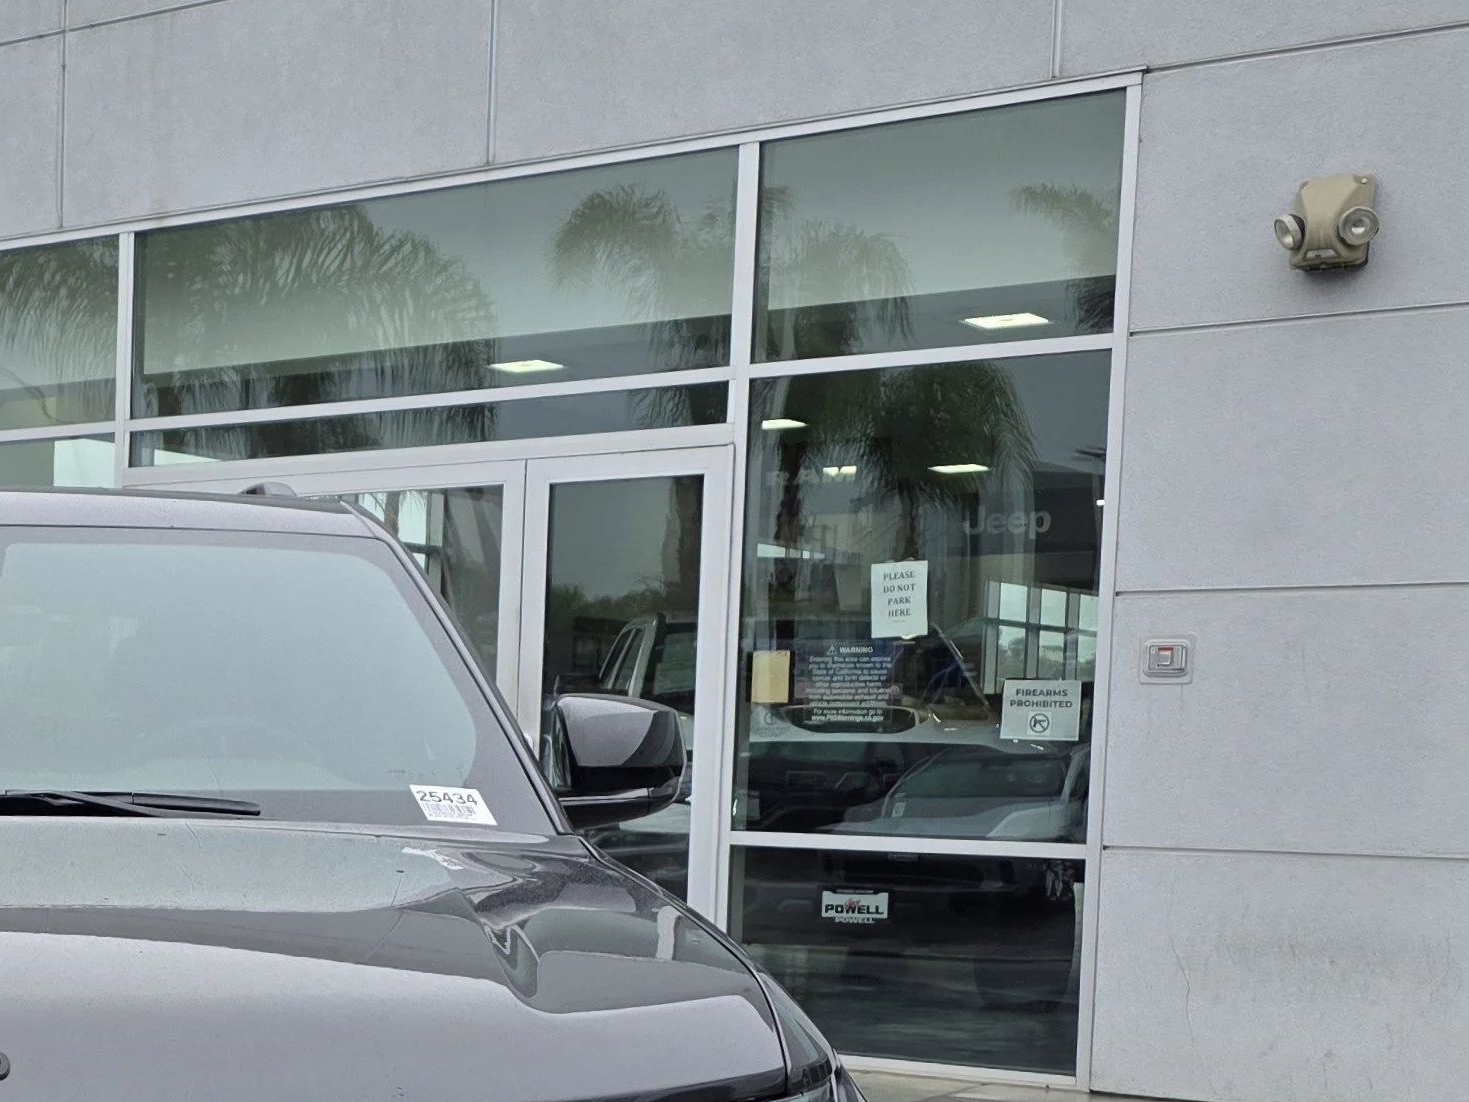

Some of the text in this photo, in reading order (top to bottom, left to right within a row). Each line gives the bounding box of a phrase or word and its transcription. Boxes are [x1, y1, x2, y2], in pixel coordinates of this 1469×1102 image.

[963, 505, 1051, 540] Jeep
[883, 571, 916, 581] PLEASE
[883, 583, 916, 594] DO NOT
[887, 597, 911, 606] PARK
[888, 608, 911, 618] HERE
[839, 646, 874, 654] WARNING
[1015, 688, 1069, 697] FIREARMS
[1009, 699, 1073, 708] PROHIBITED
[416, 790, 478, 806] 25434
[825, 904, 884, 915] POWELL
[835, 916, 875, 924] POWELL
